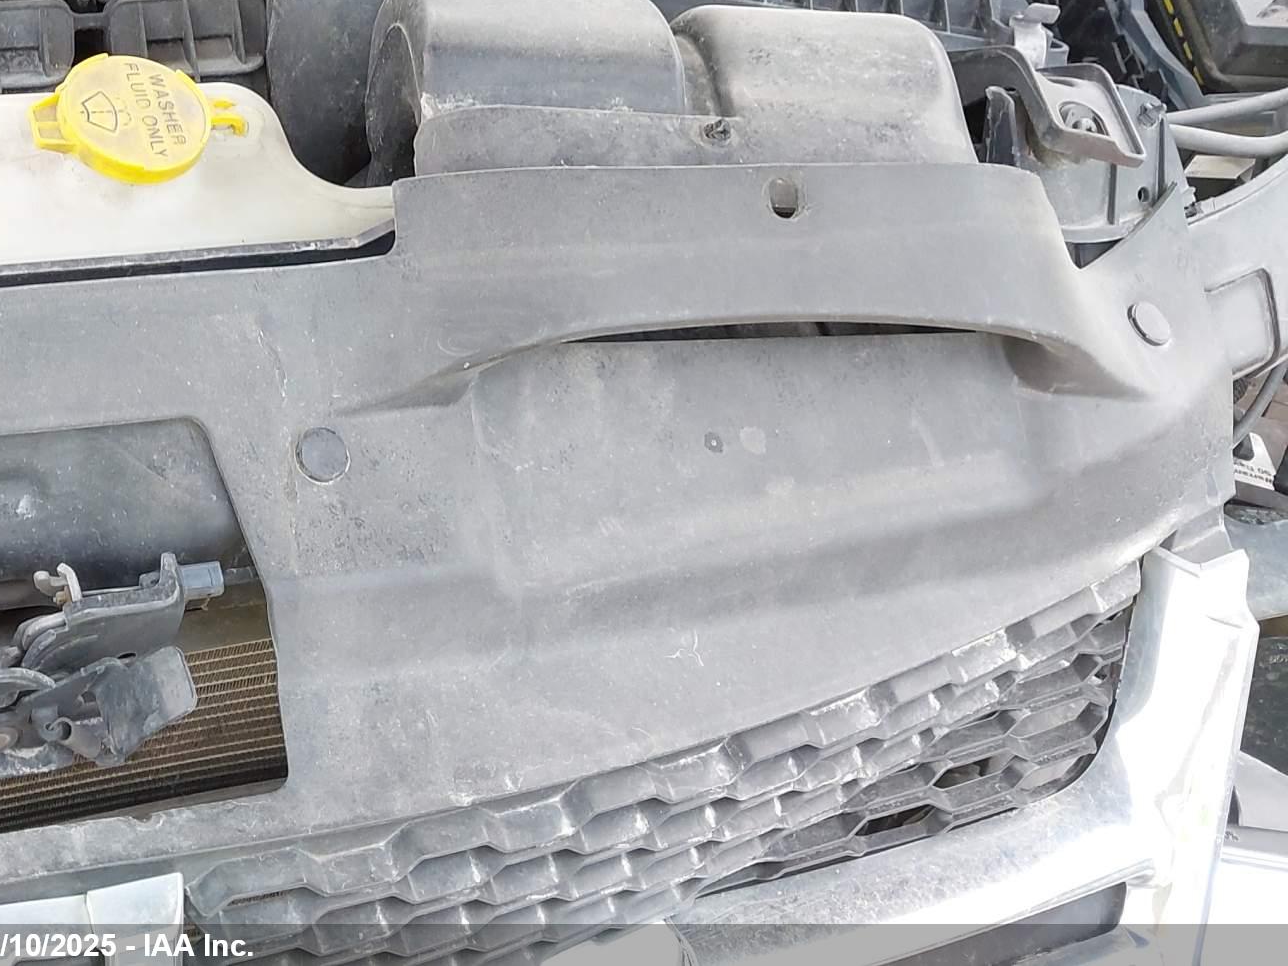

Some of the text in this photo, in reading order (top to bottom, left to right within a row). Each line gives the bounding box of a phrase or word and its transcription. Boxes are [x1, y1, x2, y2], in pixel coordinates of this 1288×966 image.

[123, 62, 169, 158] FLUID ONLY
[148, 73, 187, 146] WASHER
